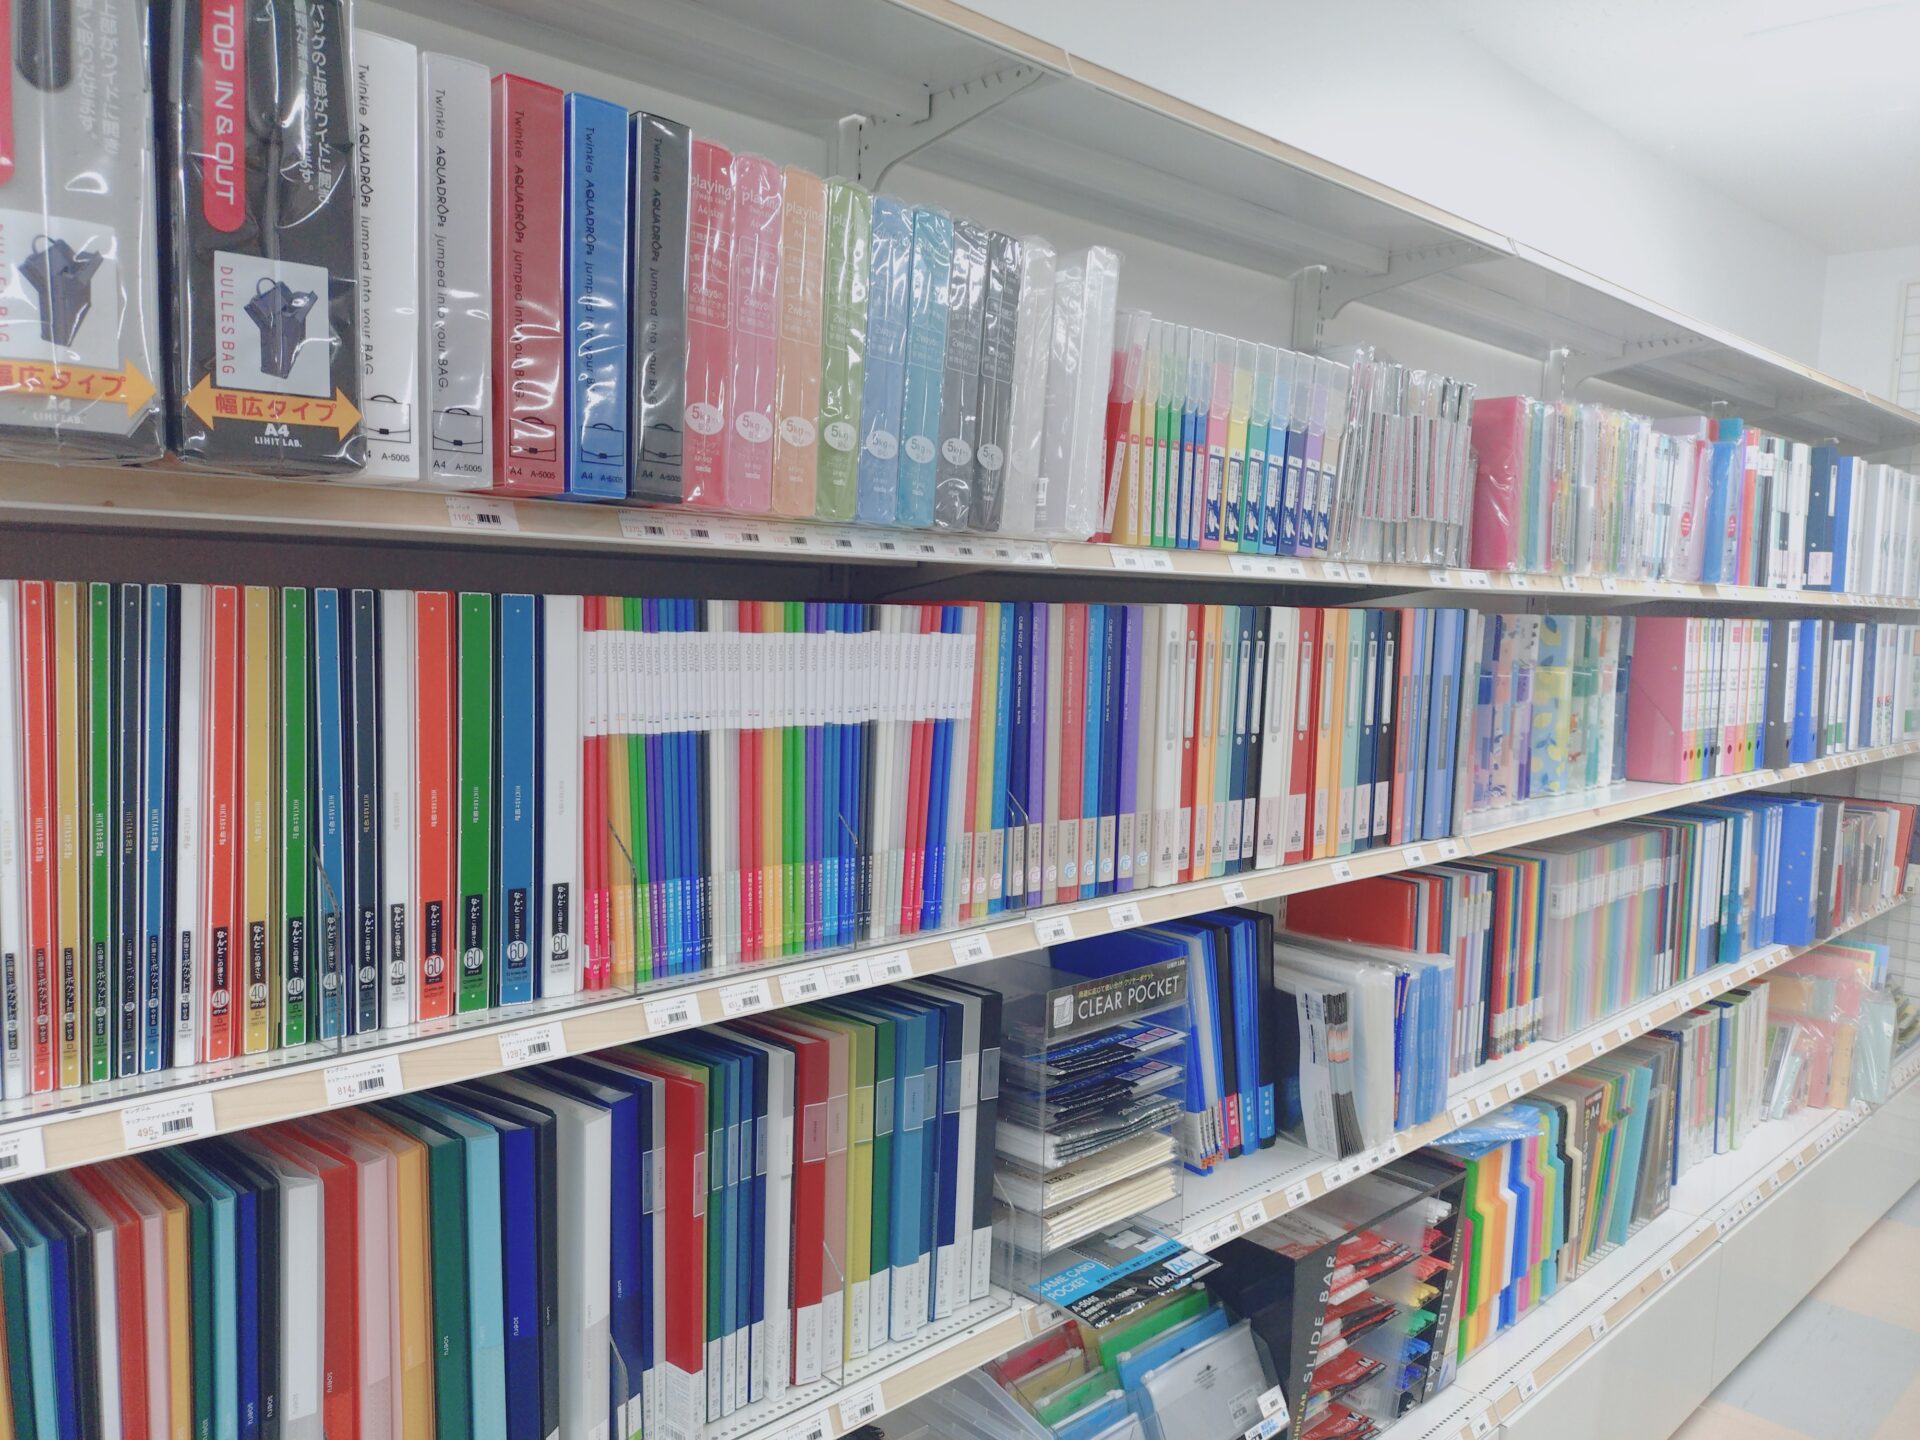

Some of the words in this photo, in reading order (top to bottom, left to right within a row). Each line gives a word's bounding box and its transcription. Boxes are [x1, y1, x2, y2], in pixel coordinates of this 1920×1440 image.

[213, 4, 235, 71] TOP
[215, 82, 234, 109] IN
[358, 64, 370, 115] Twinkle
[435, 89, 446, 139] Twinkle
[216, 117, 234, 138] &
[514, 111, 524, 158] Twinkle
[585, 127, 595, 173] Twinkle
[652, 138, 662, 182] Twinkle
[215, 146, 235, 205] OUT
[691, 175, 732, 201] playing
[435, 234, 447, 287] jumped
[220, 266, 235, 335] DULLES
[649, 267, 660, 316] jumped
[221, 341, 235, 374] BAG
[215, 393, 337, 422] 幅広タイプ
[264, 423, 290, 437] A4
[742, 414, 760, 432] 5kg
[254, 436, 280, 446] LIHIT
[282, 438, 303, 447] LAB.
[381, 452, 410, 463] A-5005
[433, 459, 446, 470] A4
[455, 463, 482, 473] A-5005
[510, 466, 523, 476] A4
[530, 470, 556, 480] A-5005
[581, 471, 593, 481] A4
[641, 469, 653, 479] A4
[510, 944, 526, 959] 60
[553, 935, 568, 951] 60
[427, 959, 442, 974] 60
[466, 951, 482, 966] 60
[361, 968, 375, 981] 40
[391, 963, 404, 977] 40
[251, 984, 266, 1000] 40
[289, 978, 303, 993] 40
[213, 990, 228, 1006] 40
[1078, 991, 1122, 1020] CLEAR
[1128, 975, 1179, 1006] POCKET
[137, 1127, 154, 1137] 495
[1066, 1261, 1096, 1277] CARD
[1169, 1258, 1193, 1275] A4
[1047, 1277, 1089, 1300] POCKET
[1434, 1279, 1453, 1338] SLIDE
[1303, 1316, 1325, 1383] SLIDE
[1319, 1255, 1337, 1303] BAR
[1425, 1351, 1440, 1393] BAR
